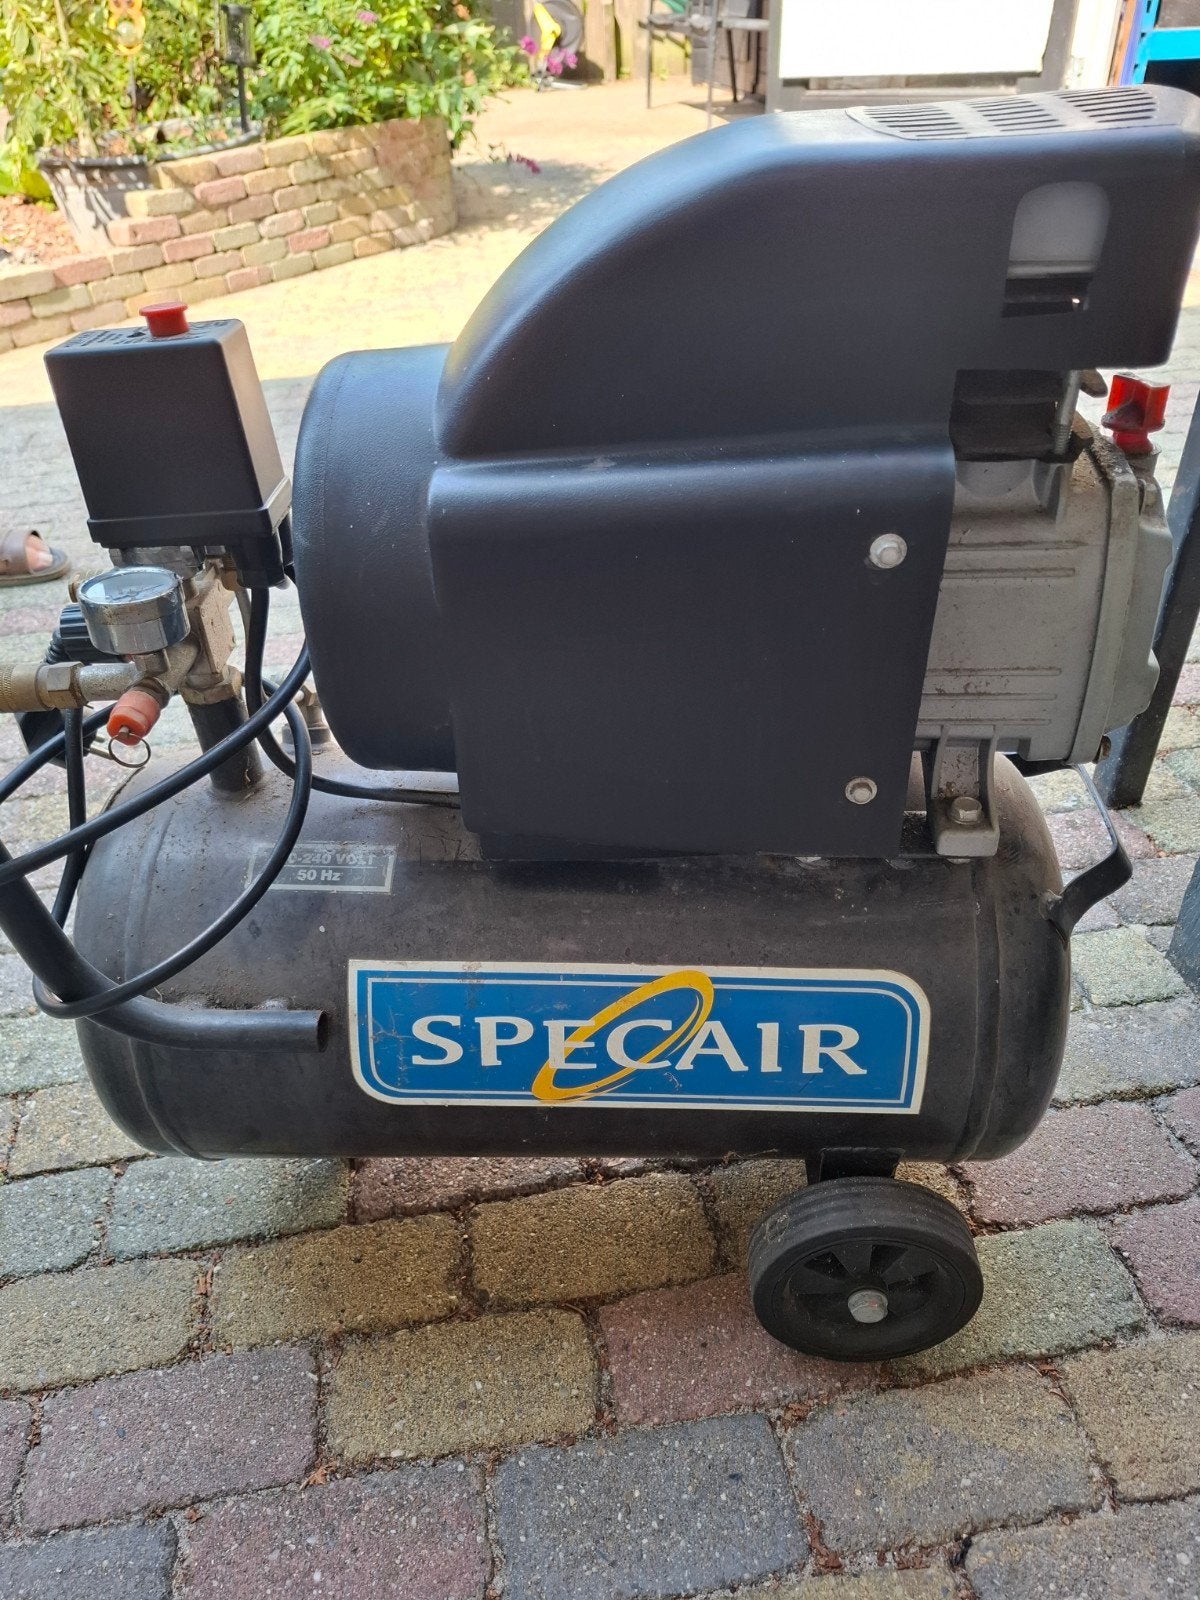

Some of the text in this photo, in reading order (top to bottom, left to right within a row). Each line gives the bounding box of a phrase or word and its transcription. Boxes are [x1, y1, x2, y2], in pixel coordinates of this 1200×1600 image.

[287, 852, 377, 866] 0-240 VOLT
[297, 869, 343, 881] 50 Hz
[411, 1014, 868, 1075] SPECAIR
